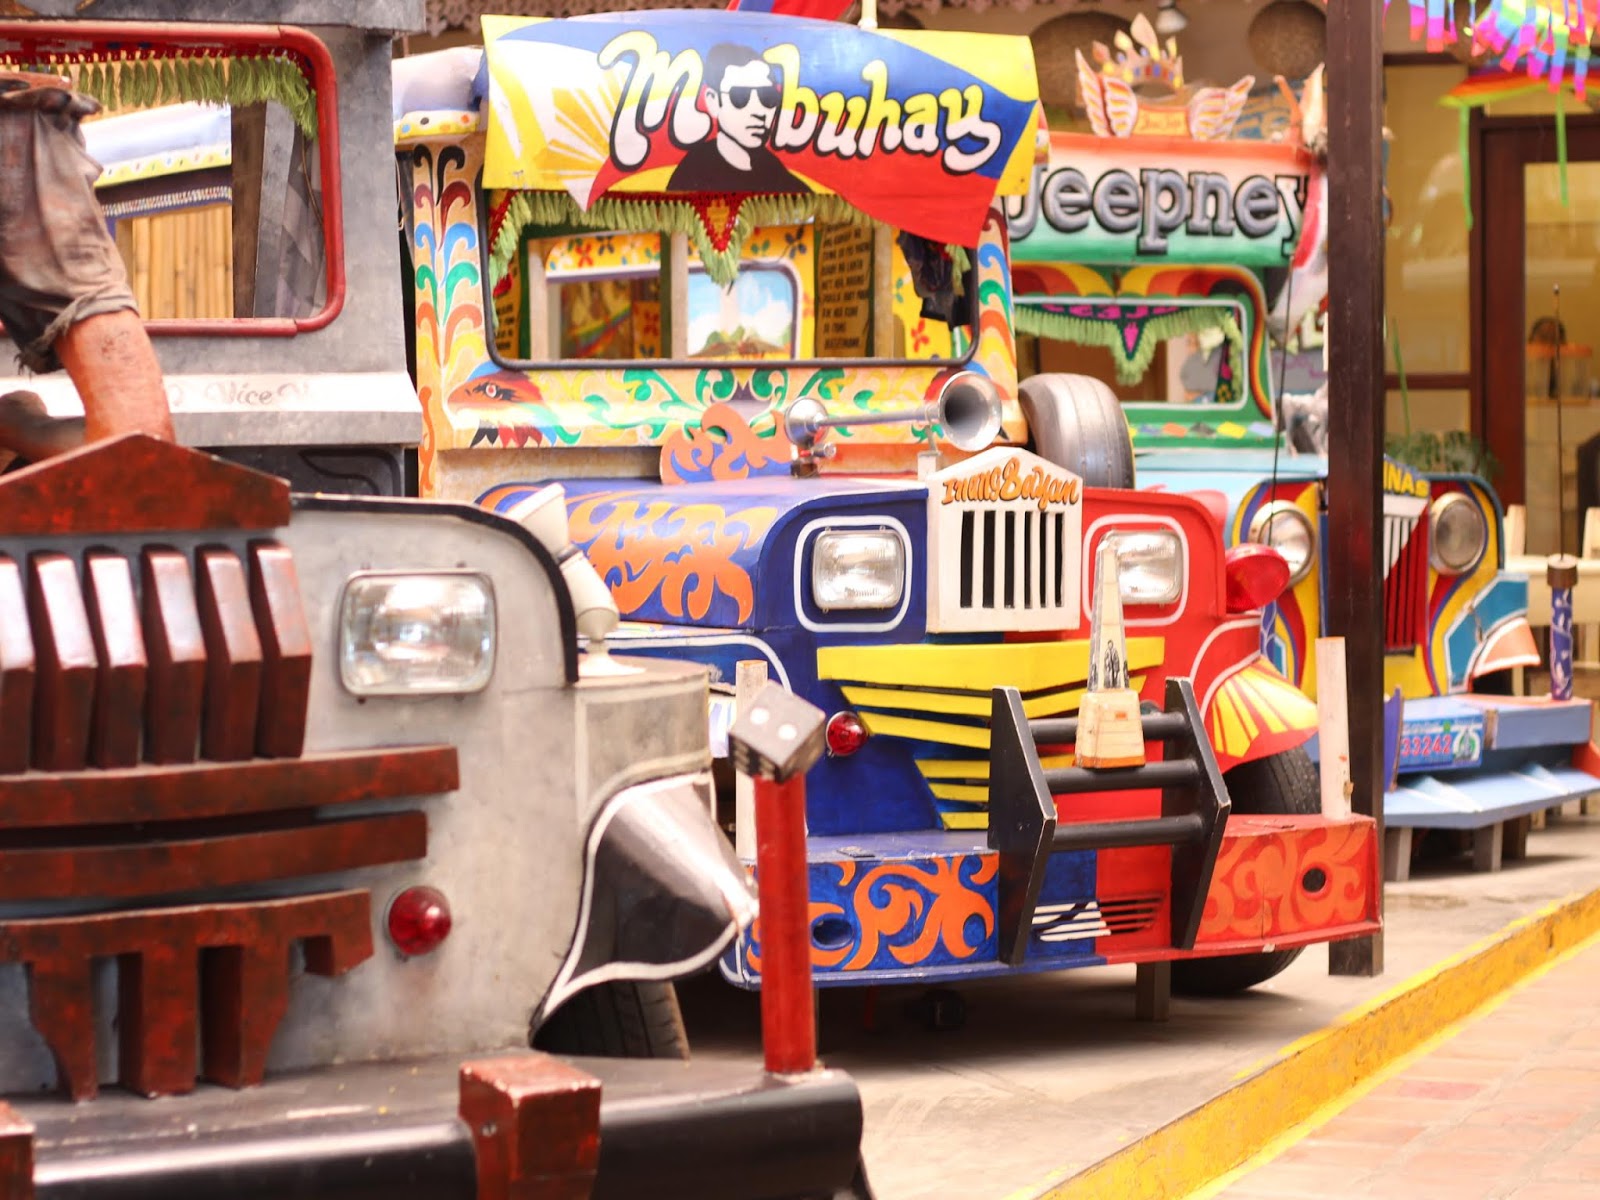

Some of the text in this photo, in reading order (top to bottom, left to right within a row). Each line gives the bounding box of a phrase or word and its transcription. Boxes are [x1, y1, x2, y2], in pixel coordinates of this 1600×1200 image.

[598, 31, 1001, 176] Mbuhay
[1003, 166, 1309, 258] Jeepney
[1000, 457, 1080, 511] Bayan
[1383, 460, 1429, 499] INAS
